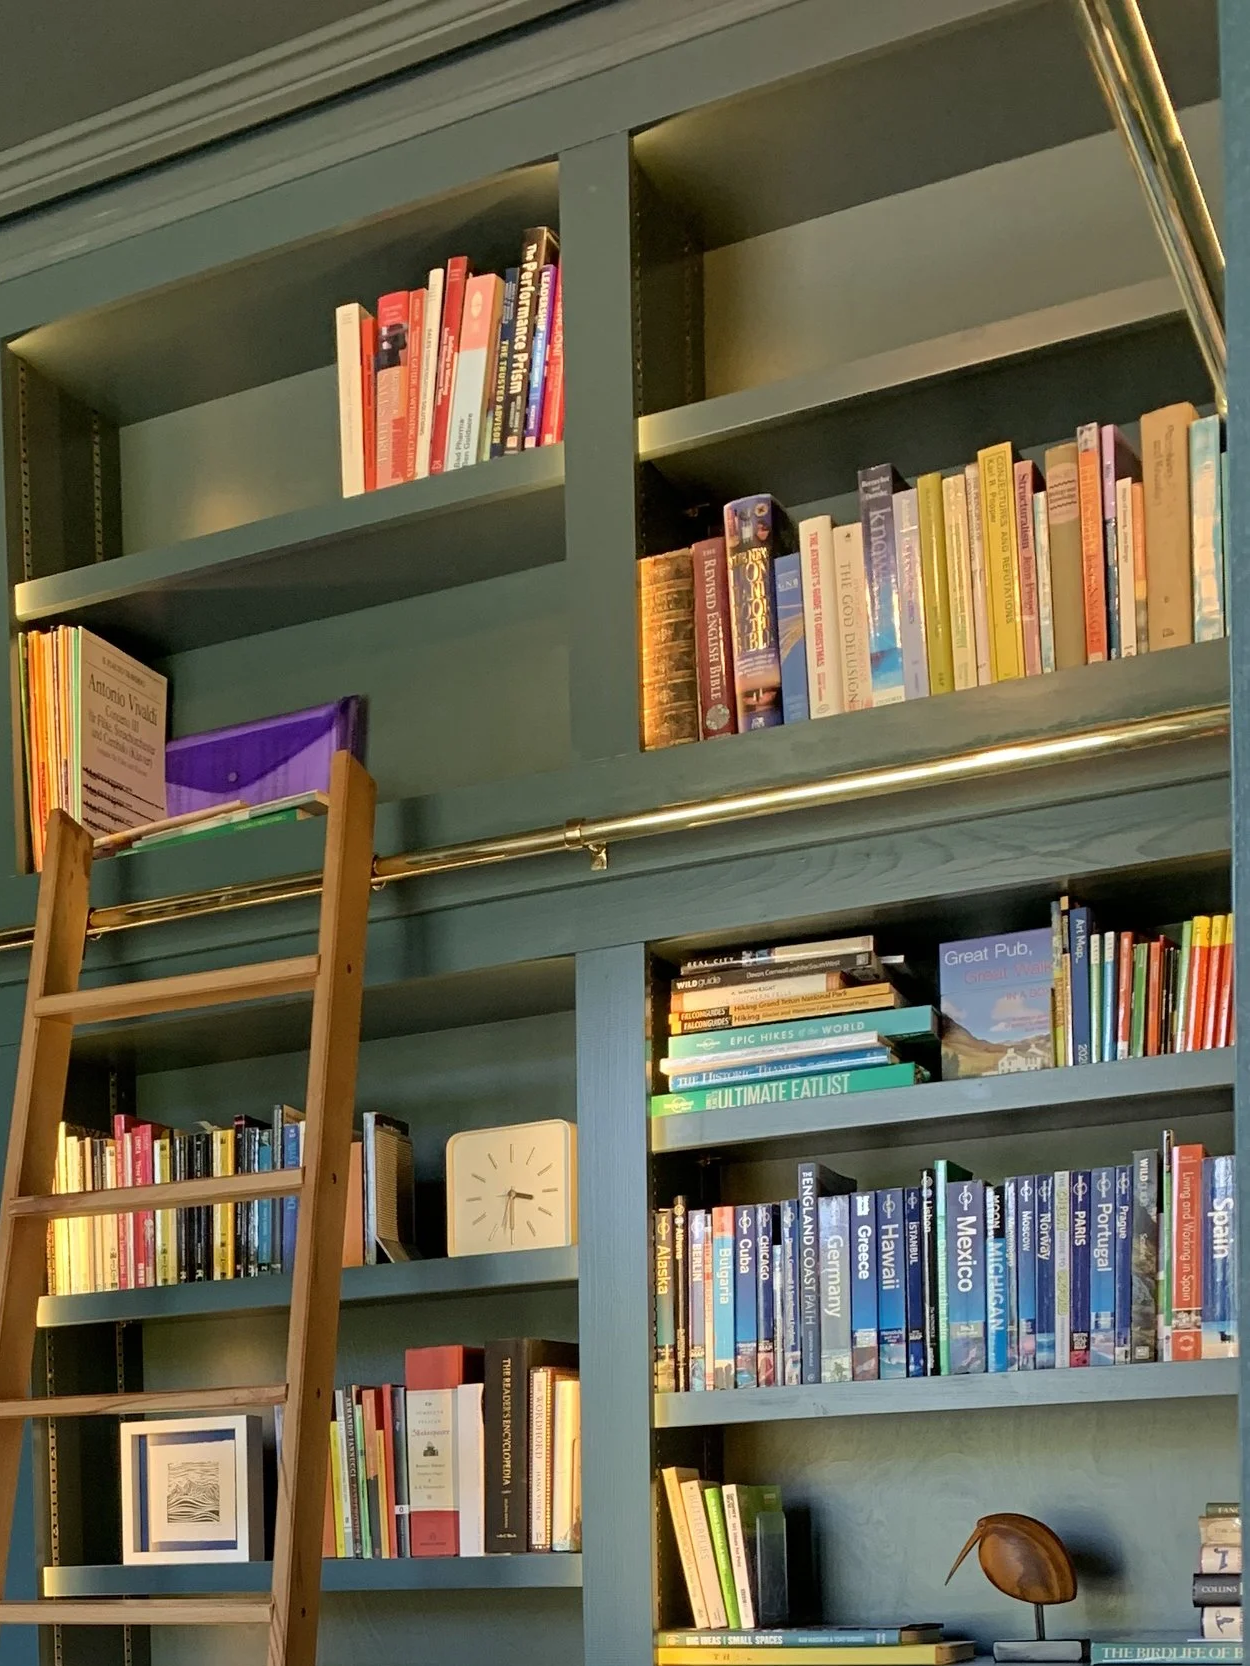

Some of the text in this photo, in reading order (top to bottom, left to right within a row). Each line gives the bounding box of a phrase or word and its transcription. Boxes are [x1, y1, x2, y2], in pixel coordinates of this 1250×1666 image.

[509, 243, 537, 394] The Performance Prism
[492, 404, 504, 444] ADVISOR
[703, 559, 722, 700] REVISED ENGLISH BIBLE
[842, 594, 855, 627] GOD
[88, 673, 126, 708] Antonio
[944, 941, 1033, 967] Great Pub,
[730, 1021, 865, 1046] EPIC HIKES WORLD
[719, 1072, 850, 1109] ULTIMATE EATLIST
[1021, 1210, 1031, 1252] Moscow
[1038, 1213, 1051, 1260] Norway
[1074, 1210, 1087, 1247] PARIS
[1093, 1202, 1113, 1272] Portugal
[1117, 1205, 1129, 1239] Prague
[1180, 1171, 1193, 1301] Living and Working Spain
[1207, 1197, 1235, 1259] Spain
[657, 1245, 672, 1295] Alaska
[692, 1243, 702, 1282] BERLIN
[739, 1238, 751, 1274] Cuba
[759, 1235, 770, 1280] CHICAGO
[802, 1178, 815, 1325] ENGLAND COAST PATH
[857, 1225, 872, 1281] Greece
[880, 1223, 899, 1291] Hawaii
[957, 1216, 977, 1292] Mexico
[717, 1247, 732, 1305] Bulgaria
[823, 1234, 844, 1318] Germany
[989, 1242, 1005, 1331] MICHIGAN
[1201, 1585, 1237, 1593] COLLINS
[727, 1635, 783, 1645] SMALL SPACES
[1102, 1647, 1133, 1659] THE
[1136, 1647, 1206, 1660] BIRDLIFE
[1209, 1647, 1229, 1659] OF
